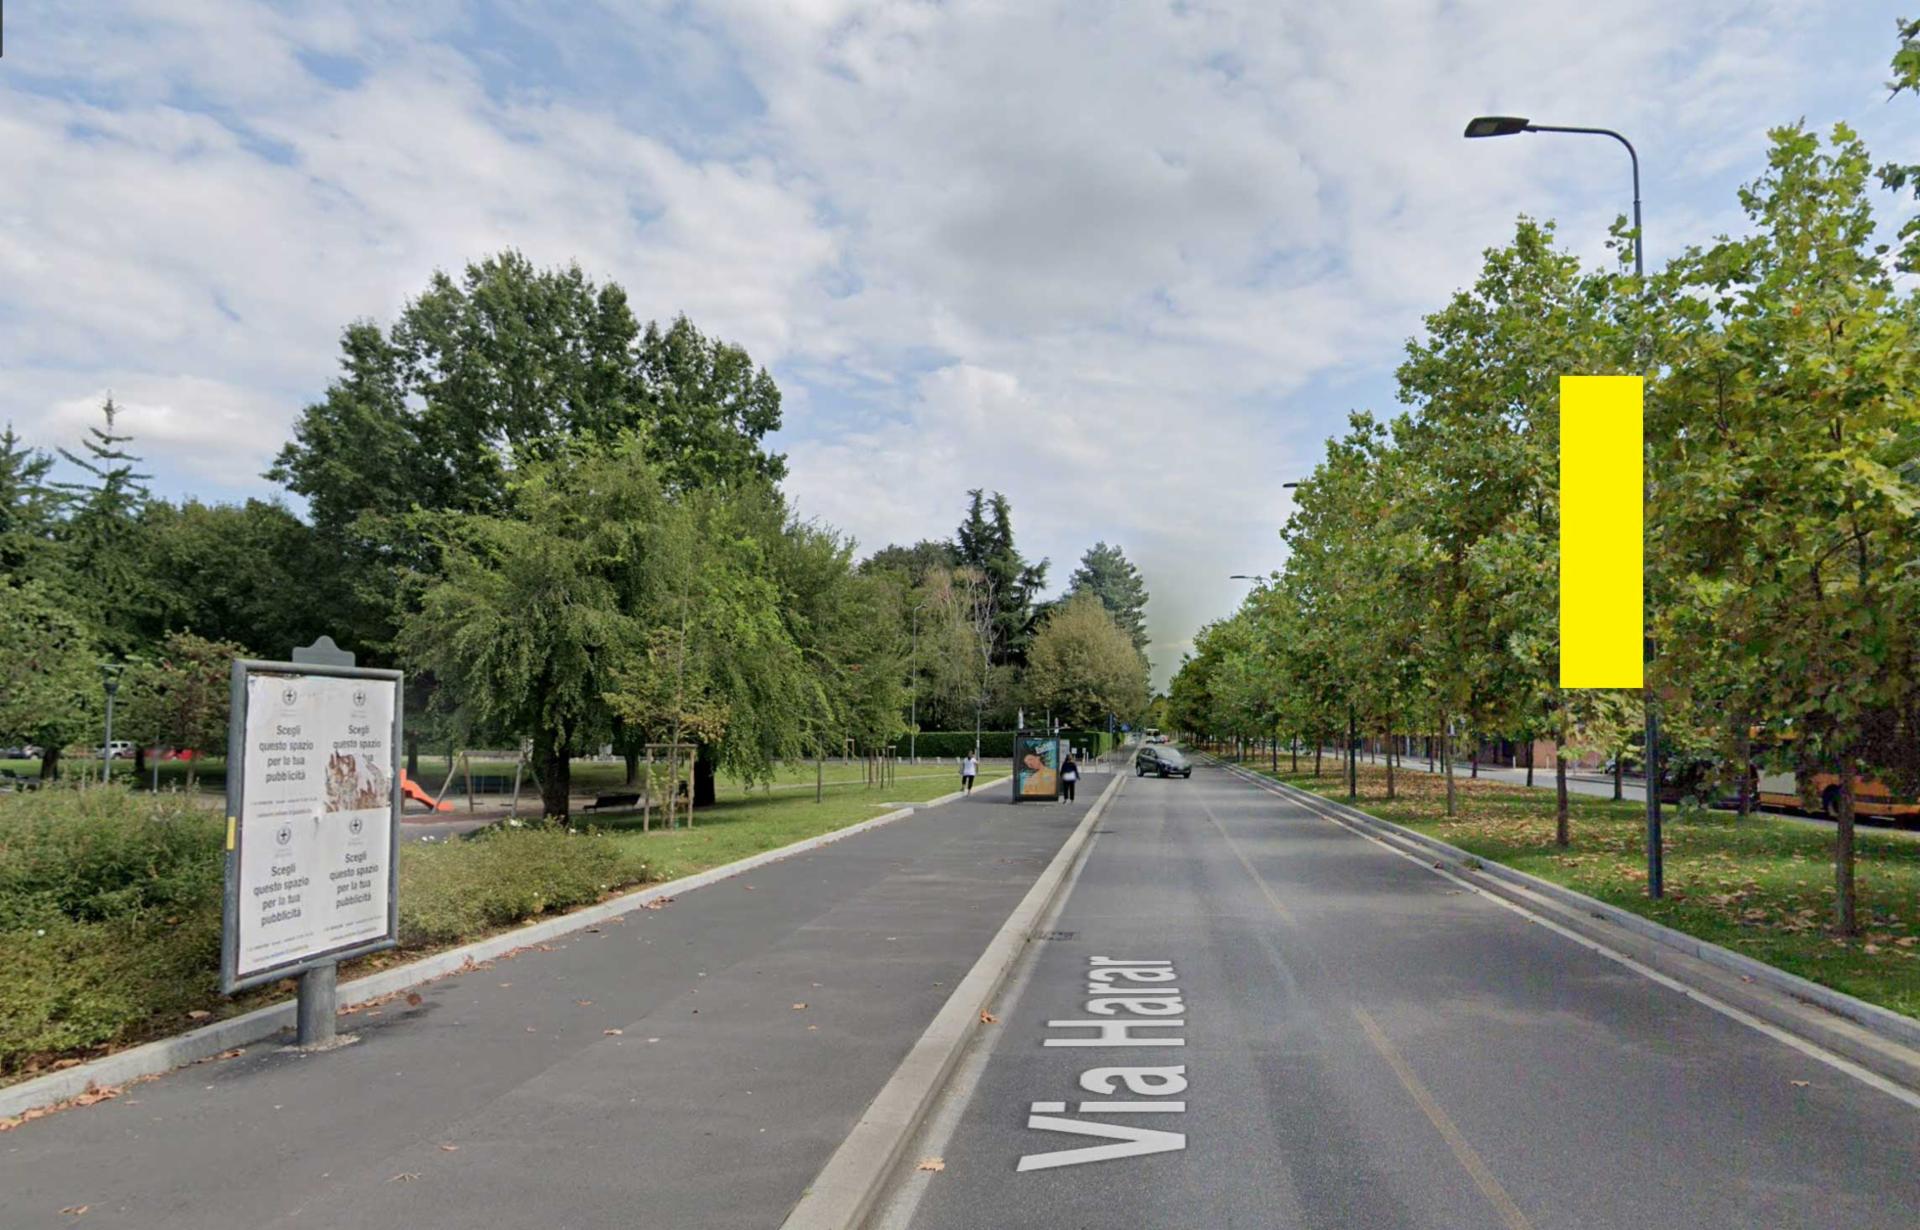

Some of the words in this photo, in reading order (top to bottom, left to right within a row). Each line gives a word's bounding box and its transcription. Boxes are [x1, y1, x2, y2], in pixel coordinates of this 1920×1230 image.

[276, 725, 301, 737] Scegli
[348, 725, 370, 736] Scegli
[259, 741, 287, 752] questo
[289, 741, 314, 752] spazio
[333, 740, 357, 750] questo
[359, 740, 381, 750] spazio
[267, 757, 281, 767] per
[292, 756, 305, 765] tua
[345, 851, 367, 863] Scegli
[271, 863, 296, 877] Scegli
[329, 868, 355, 880] questo
[356, 864, 379, 877] spazio
[253, 882, 282, 896] questo
[284, 877, 309, 891] spazio
[337, 884, 349, 894] per
[351, 881, 357, 890] la
[359, 880, 371, 889] tua
[262, 899, 276, 911] per
[278, 896, 285, 905] la
[288, 894, 300, 904] tua
